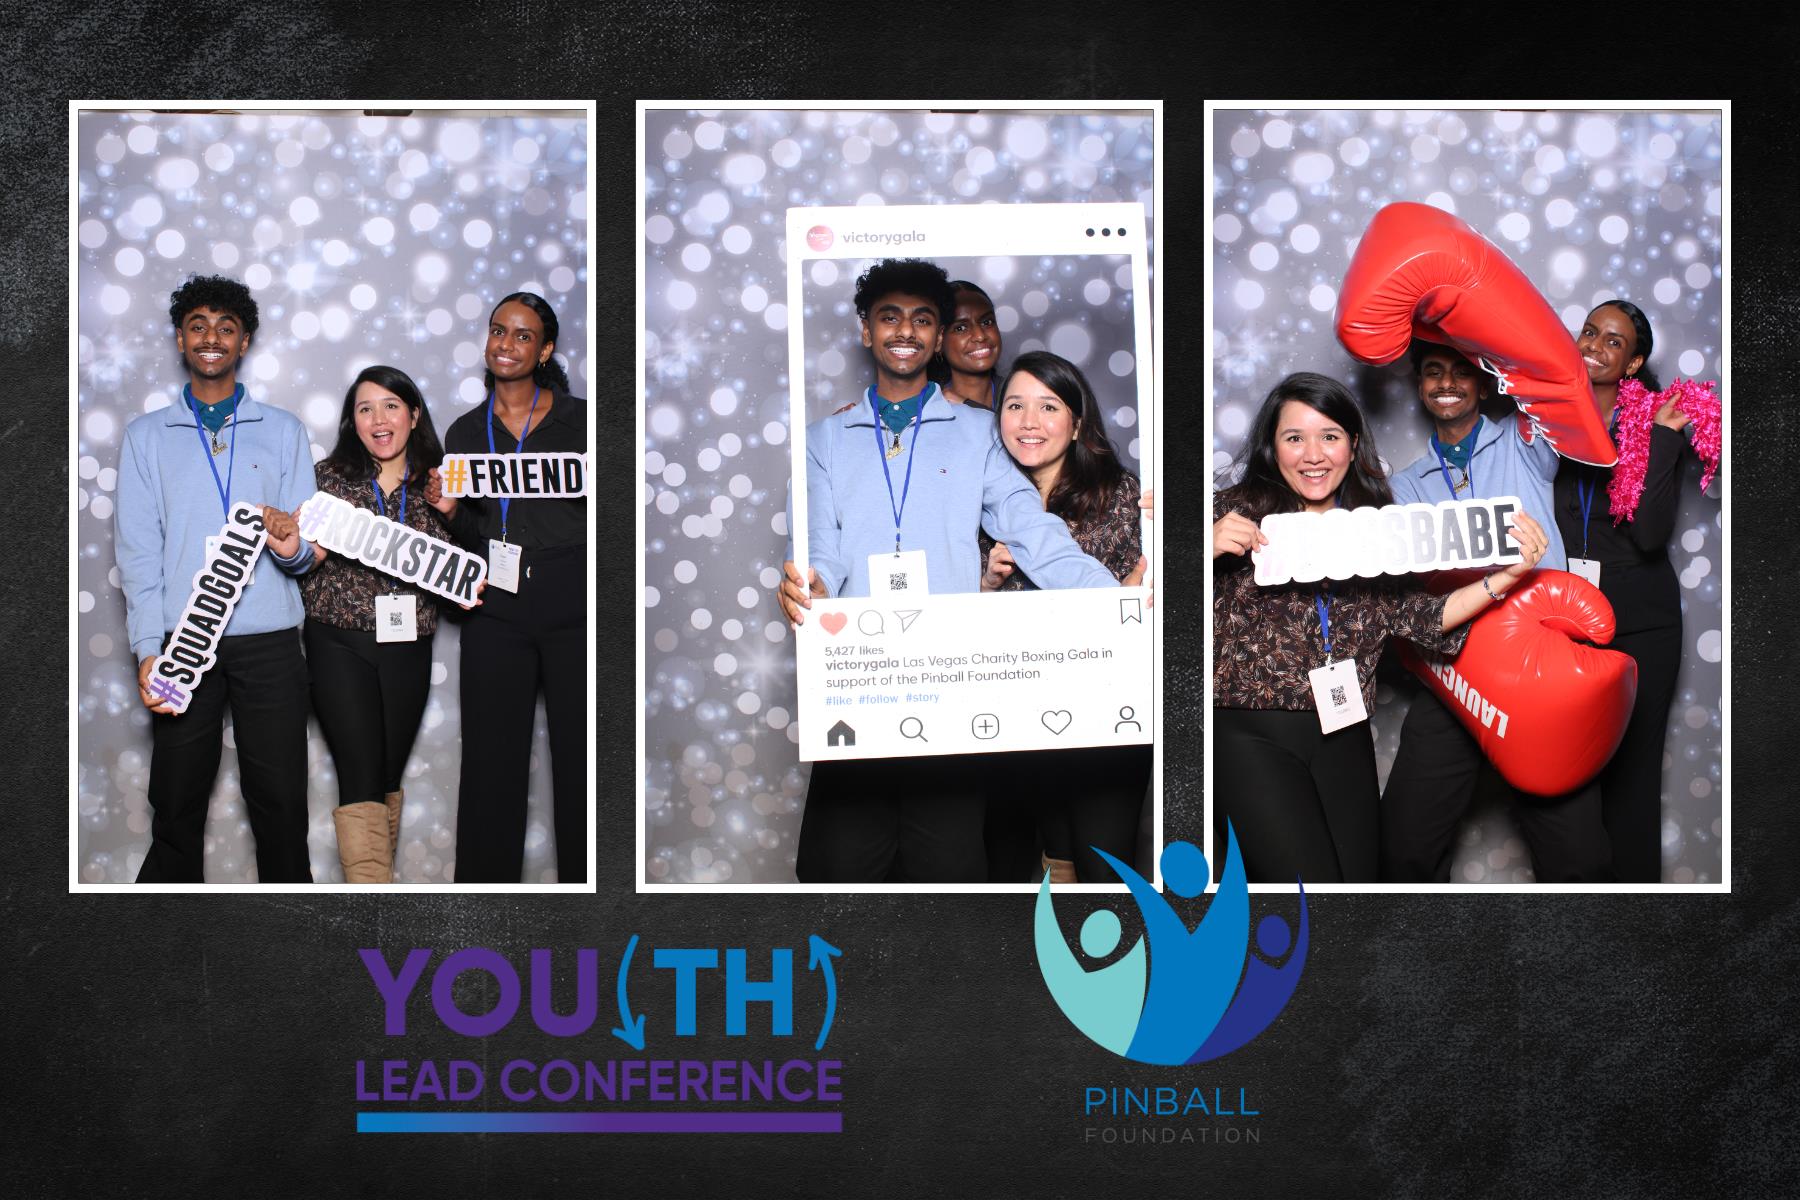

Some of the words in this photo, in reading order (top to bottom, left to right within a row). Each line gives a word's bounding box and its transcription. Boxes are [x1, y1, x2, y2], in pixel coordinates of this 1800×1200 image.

[842, 230, 926, 245] victorygala
[444, 458, 587, 494] #FRIEND
[300, 499, 481, 601] #ROCKSTAR
[150, 508, 266, 708] #SQUADGOALS
[825, 646, 855, 657] 5,427
[859, 645, 884, 656] likes
[825, 657, 899, 671] victorygala
[903, 656, 925, 668] Las
[928, 655, 968, 668] Vegas
[971, 653, 1018, 665] Charity
[1021, 650, 1064, 663] Boxing
[1067, 648, 1099, 660] Gala
[1102, 648, 1113, 659] in
[826, 676, 877, 689] support
[880, 674, 894, 686] of
[897, 674, 918, 685] the
[921, 671, 964, 684] Pinball
[967, 668, 1041, 682] Foundation
[825, 695, 853, 706] #like
[859, 693, 899, 704] #follow
[905, 691, 940, 704] #story
